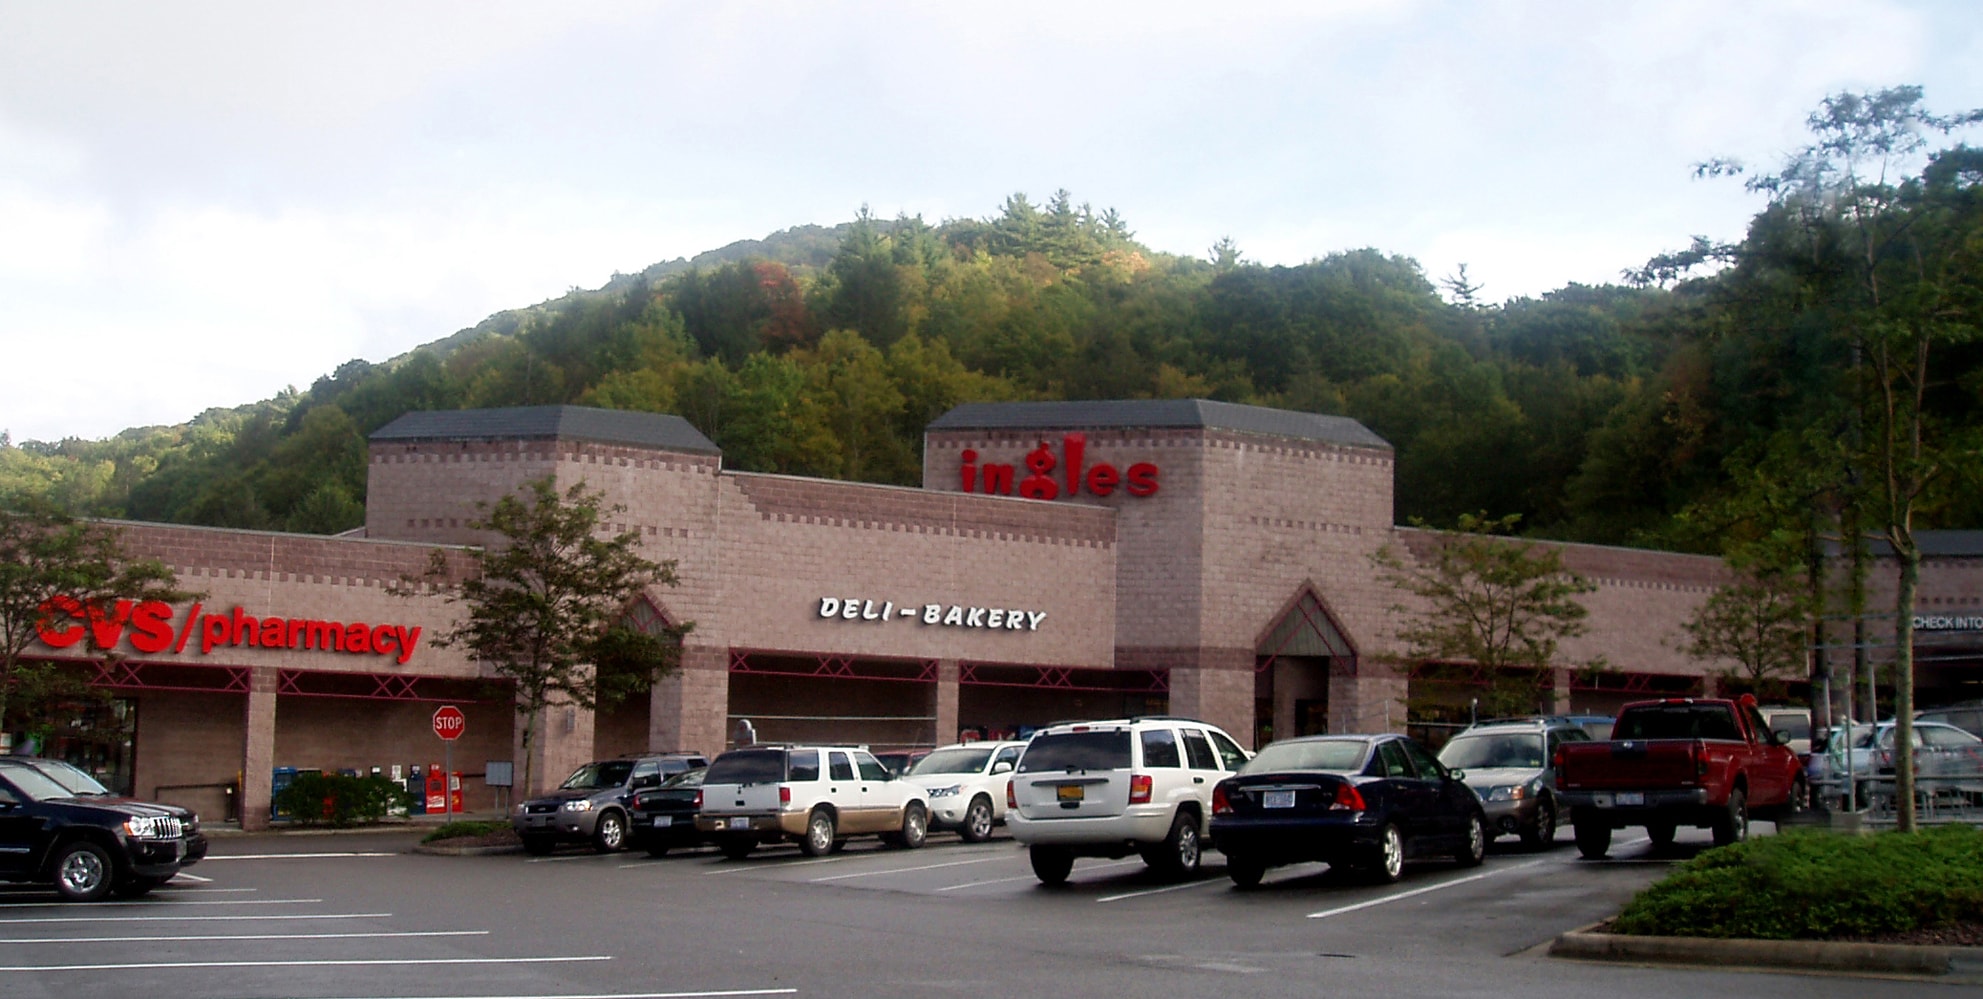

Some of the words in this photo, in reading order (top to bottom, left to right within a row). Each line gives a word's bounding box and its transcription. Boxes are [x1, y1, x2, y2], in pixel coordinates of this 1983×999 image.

[960, 432, 1160, 501] ingles
[1912, 616, 1954, 630] CHECK
[435, 716, 463, 730] STOP
